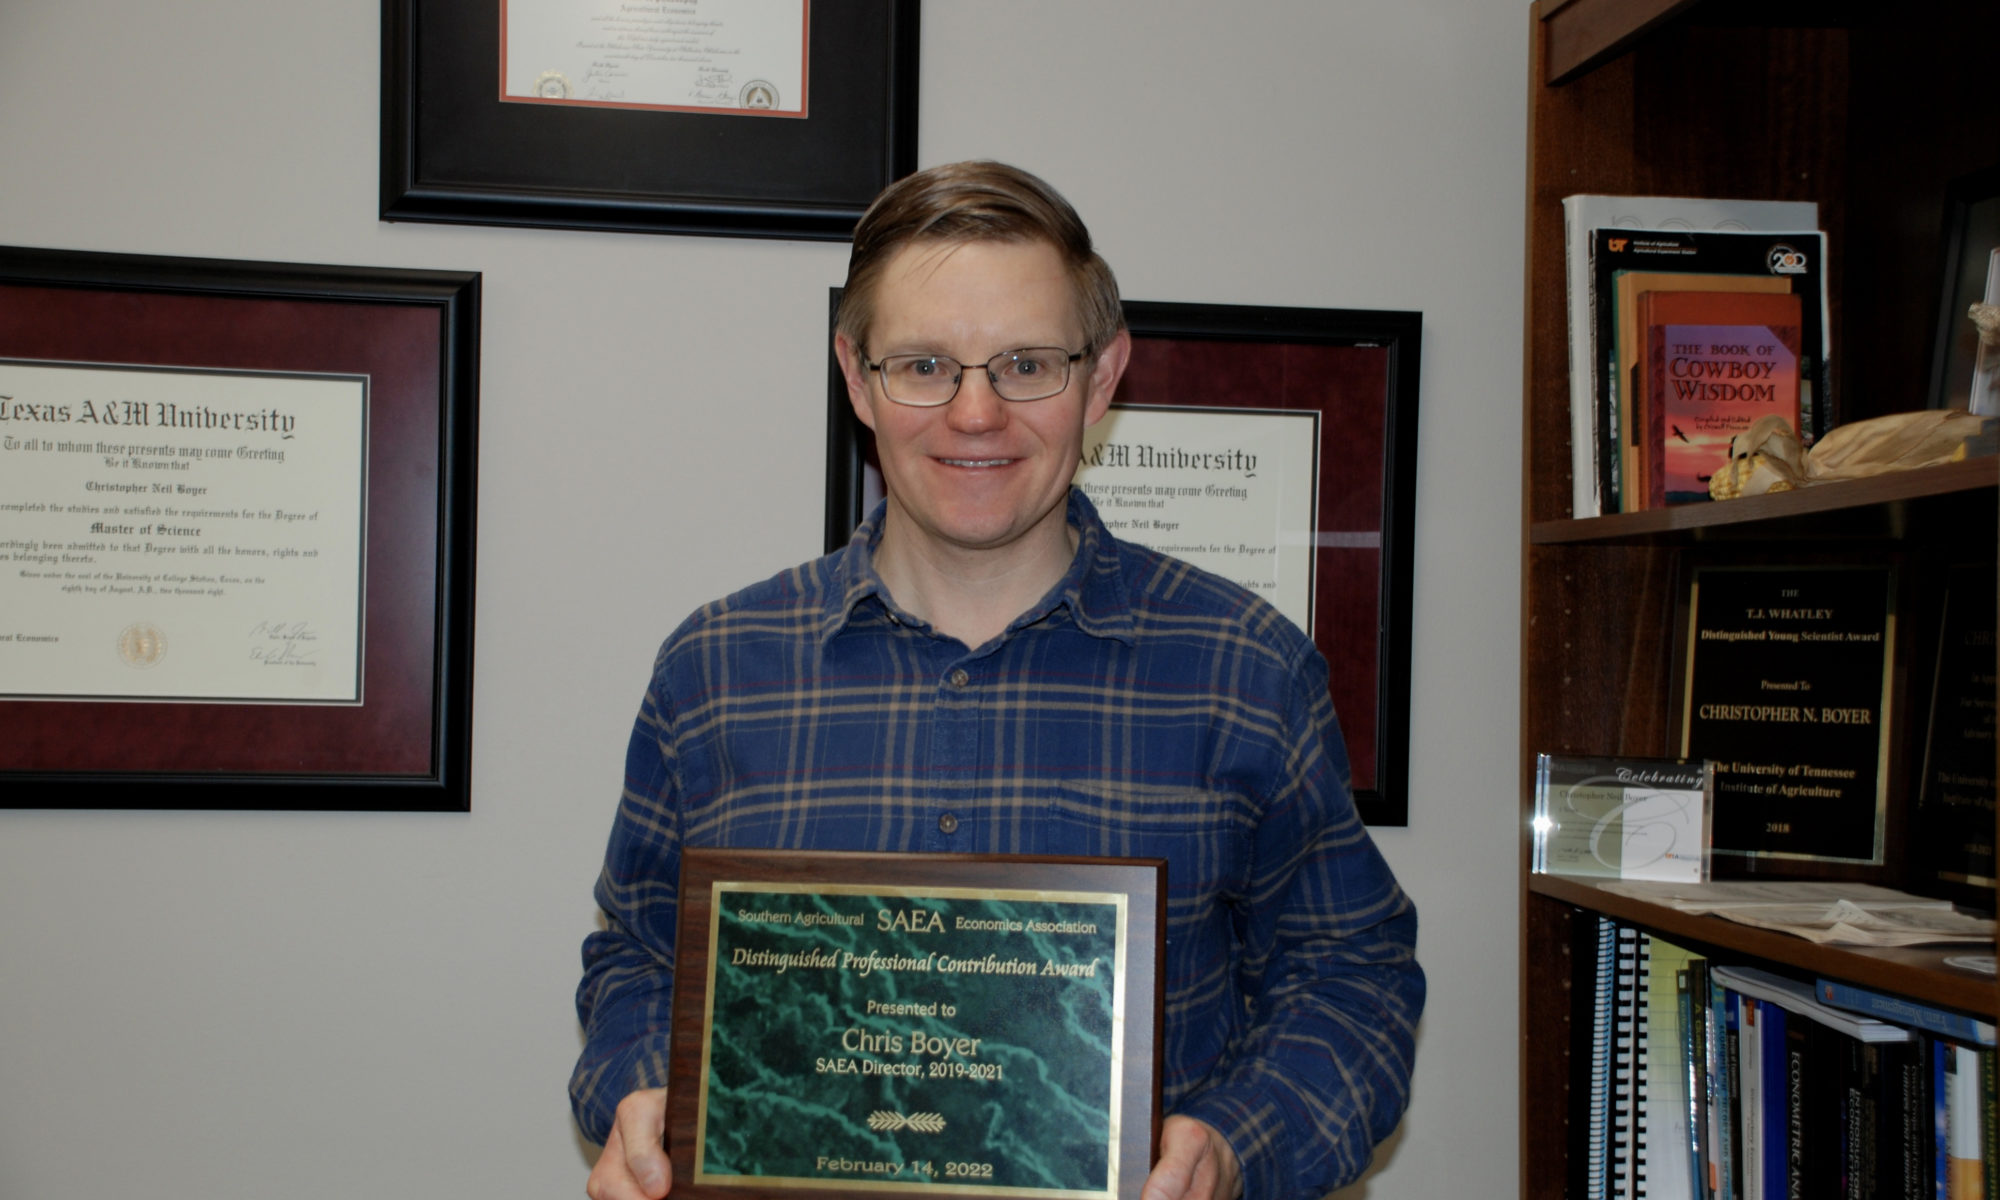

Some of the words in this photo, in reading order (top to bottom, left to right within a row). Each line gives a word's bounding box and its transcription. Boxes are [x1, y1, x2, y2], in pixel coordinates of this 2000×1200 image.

[1672, 344, 1703, 355] THE
[1711, 344, 1750, 356] BOOK
[1756, 345, 1776, 356] OF
[1669, 357, 1777, 379] COWBOY
[1670, 379, 1776, 402] WISDOM
[0, 395, 71, 422] Texas
[76, 400, 149, 426] A&M
[156, 402, 295, 440] University
[4, 435, 20, 451] To
[24, 438, 38, 451] all
[42, 439, 53, 451] to
[57, 440, 93, 453] whom
[96, 441, 125, 455] these
[128, 443, 176, 458] presents
[179, 446, 203, 460] may
[205, 448, 233, 459] come
[236, 446, 285, 463] Greeting
[171, 460, 190, 471] that
[1135, 444, 1257, 478] University
[85, 481, 148, 493] Christopher
[152, 483, 172, 494] Neil
[177, 484, 207, 496] Boyer
[1111, 484, 1152, 497] presents
[1155, 486, 1175, 499] may
[1178, 487, 1202, 498] come
[1205, 485, 1247, 501] Greeting
[1148, 499, 1164, 509] that
[89, 522, 134, 534] Master
[140, 524, 152, 535] of
[157, 523, 201, 536] Science
[1132, 519, 1149, 529] Neil
[1153, 520, 1179, 531] Boyer
[1780, 588, 1800, 598] THE
[1746, 608, 1765, 620] T.J.
[1768, 608, 1834, 620] WHATLEY
[1701, 629, 1767, 643] Distinguished
[1768, 631, 1799, 643] Young
[1800, 631, 1844, 642] Scientist
[1845, 632, 1881, 642] Award
[1761, 679, 1799, 691] Presented
[1800, 680, 1811, 691] To
[1699, 703, 1800, 723] CHRISTOPHER
[1802, 706, 1818, 723] N.
[1821, 706, 1872, 725] BOYER
[1616, 767, 1704, 788] Celebrating
[1731, 762, 1786, 778] University
[1788, 763, 1800, 776] of
[1802, 765, 1856, 780] Tennessee
[1720, 781, 1763, 794] Institute
[1766, 782, 1777, 795] of
[1778, 784, 1842, 799] Agriculture
[1765, 821, 1791, 834] 2018
[738, 909, 791, 924] Southern
[794, 911, 864, 926] Agricultural
[877, 909, 946, 933] SAEA
[955, 916, 1023, 932] Economics
[1025, 919, 1097, 934] Association
[731, 948, 842, 974] Distinguished
[842, 949, 937, 978] Professional
[937, 953, 1037, 976] Contribution
[1040, 957, 1100, 978] Award
[867, 1000, 937, 1017] Presented
[941, 1002, 956, 1017] to
[841, 1028, 903, 1054] Chris
[910, 1031, 981, 1060] Boyer
[815, 1057, 858, 1074] SAEA
[862, 1059, 925, 1079] Director,
[929, 1062, 1004, 1080] 2019-2021
[1986, 1048, 1995, 1092] arm
[1790, 1051, 1802, 1163] ECONOMETRIC
[816, 1156, 905, 1175] February
[911, 1160, 939, 1177] 14,
[945, 1161, 993, 1178] 2022
